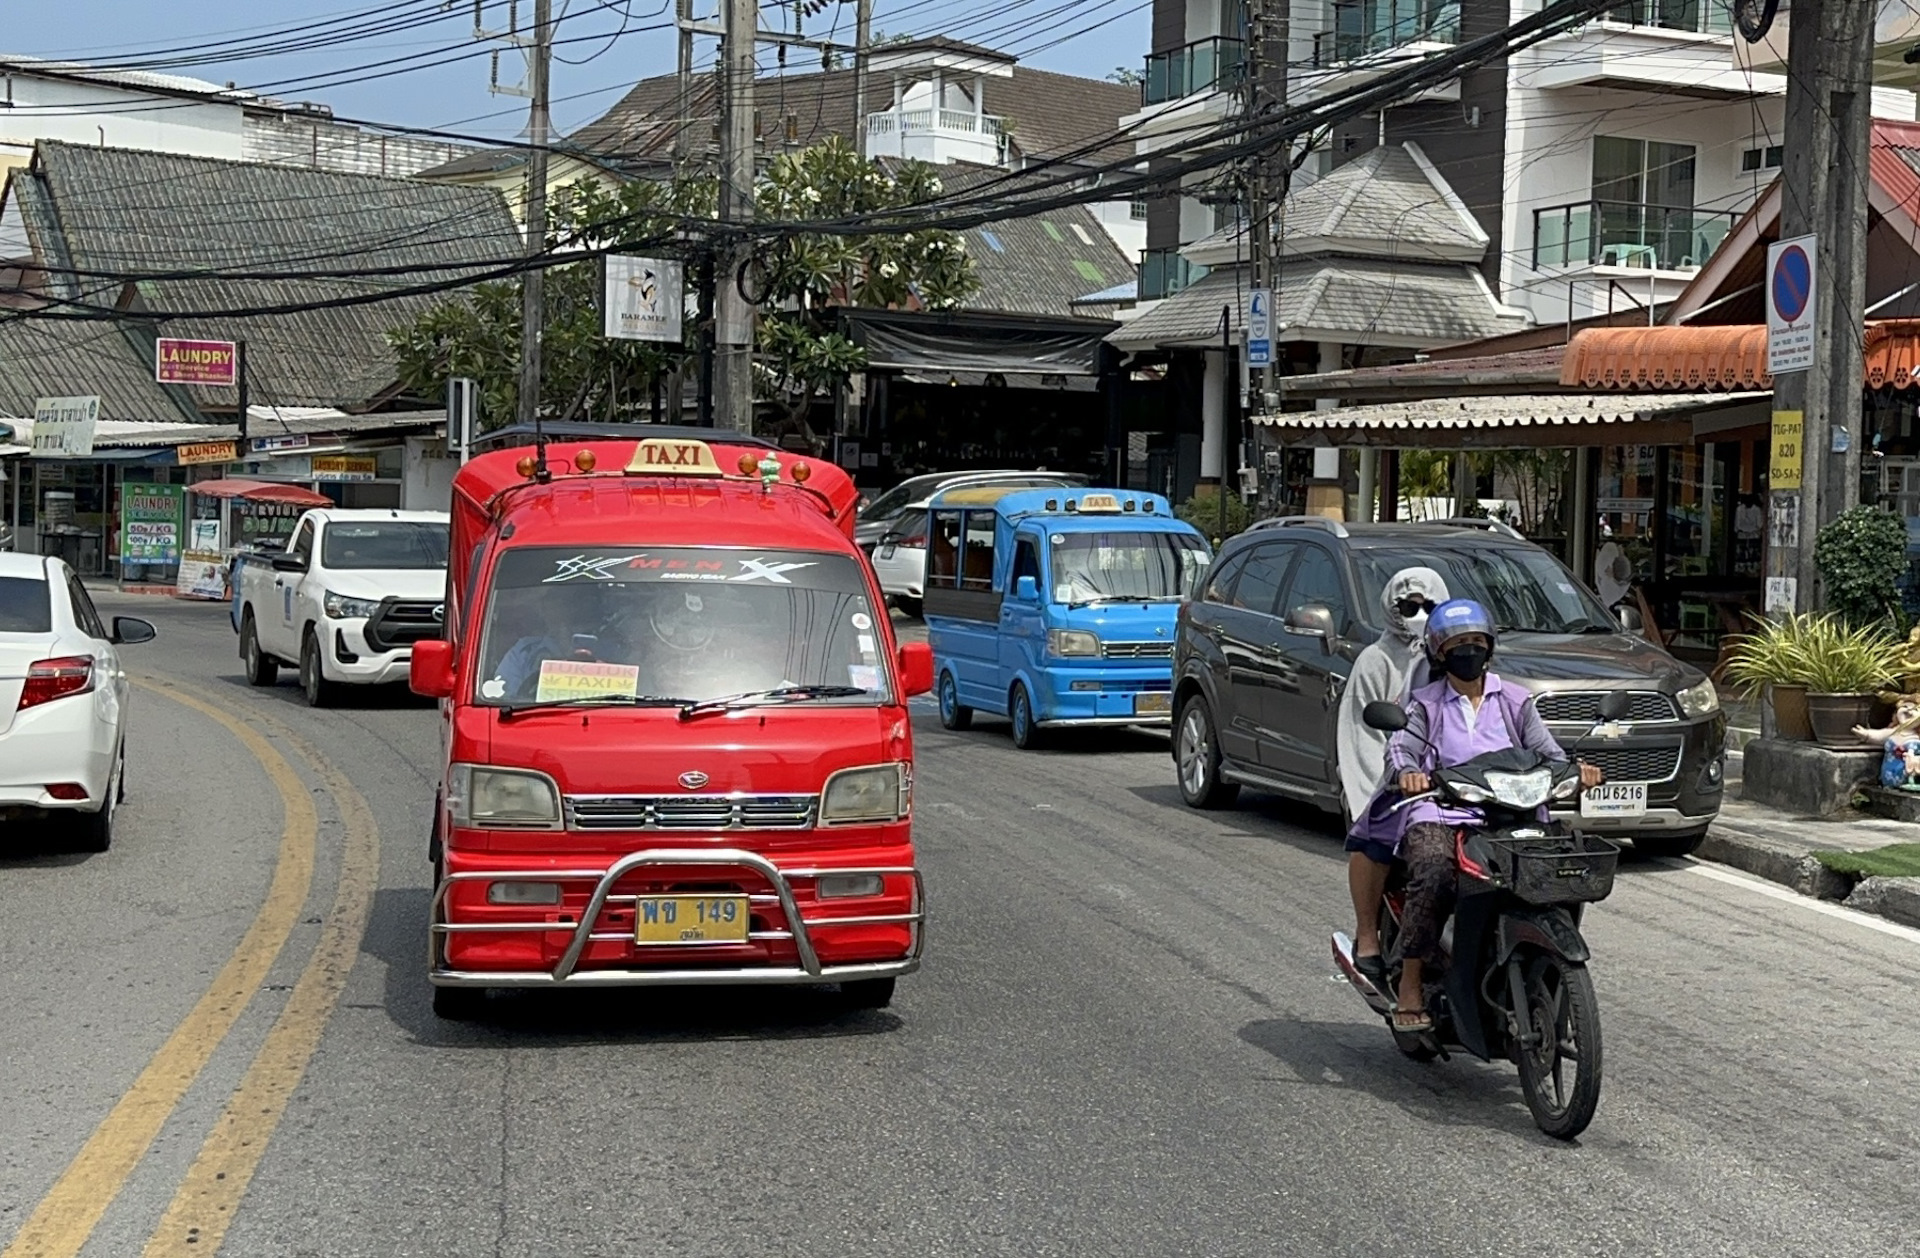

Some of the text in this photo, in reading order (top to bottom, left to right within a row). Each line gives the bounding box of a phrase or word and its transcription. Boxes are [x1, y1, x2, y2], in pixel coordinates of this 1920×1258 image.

[621, 313, 667, 322] BARAMEE
[160, 347, 231, 365] LAUNDRY
[180, 442, 232, 457] LAUNDRY
[642, 444, 701, 465] TAXI
[1778, 443, 1795, 458] 820
[127, 495, 180, 510] LAUNDRY
[1088, 497, 1112, 507] TAXI
[127, 509, 178, 519] SERVICE
[546, 662, 635, 677] TUK TUK
[564, 675, 612, 688] TAXI
[1613, 785, 1643, 800] 6216
[696, 899, 736, 923] 149
